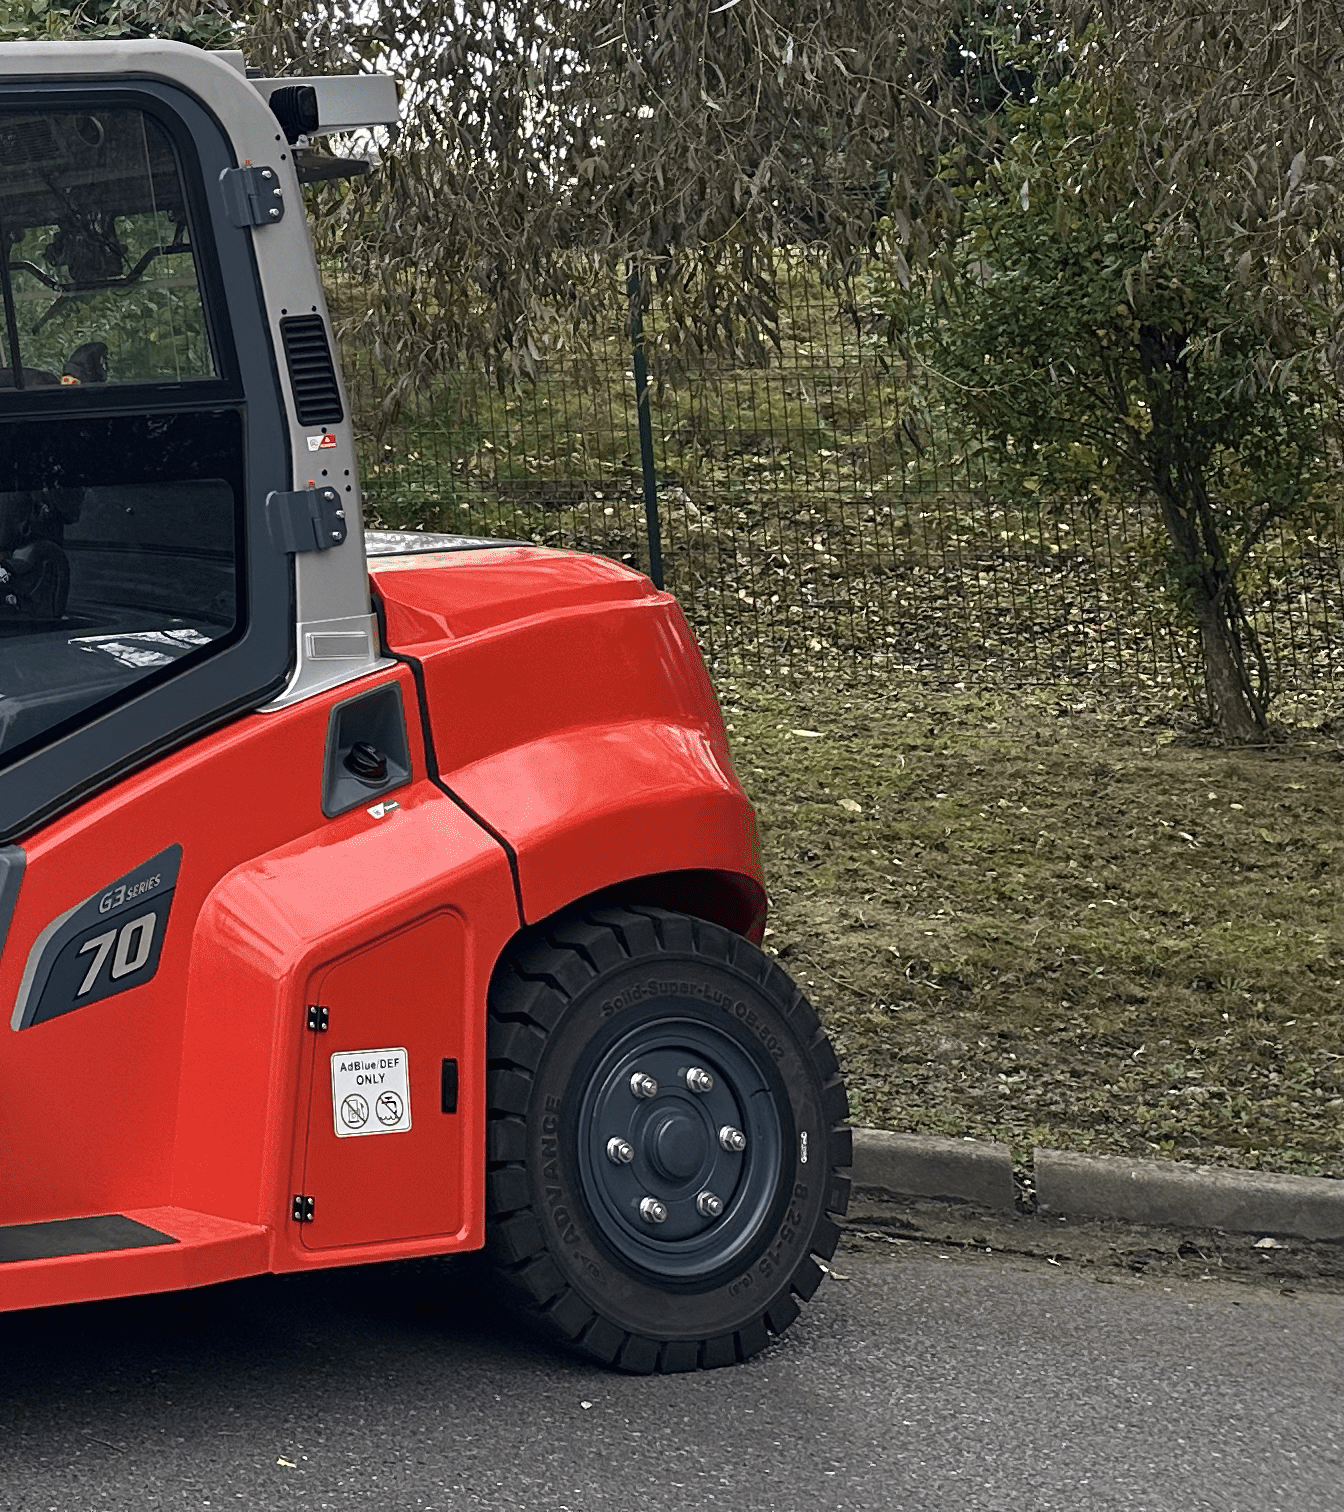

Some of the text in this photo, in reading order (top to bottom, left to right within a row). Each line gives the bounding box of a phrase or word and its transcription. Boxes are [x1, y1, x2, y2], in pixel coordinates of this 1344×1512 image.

[99, 874, 162, 914] G3 SERIES
[77, 912, 157, 996] 70
[340, 1058, 400, 1072] AdBlue/DEF
[356, 1073, 385, 1085] ONLY
[541, 1094, 580, 1245] ADVANCE
[758, 1183, 809, 1279] 8.25-15
